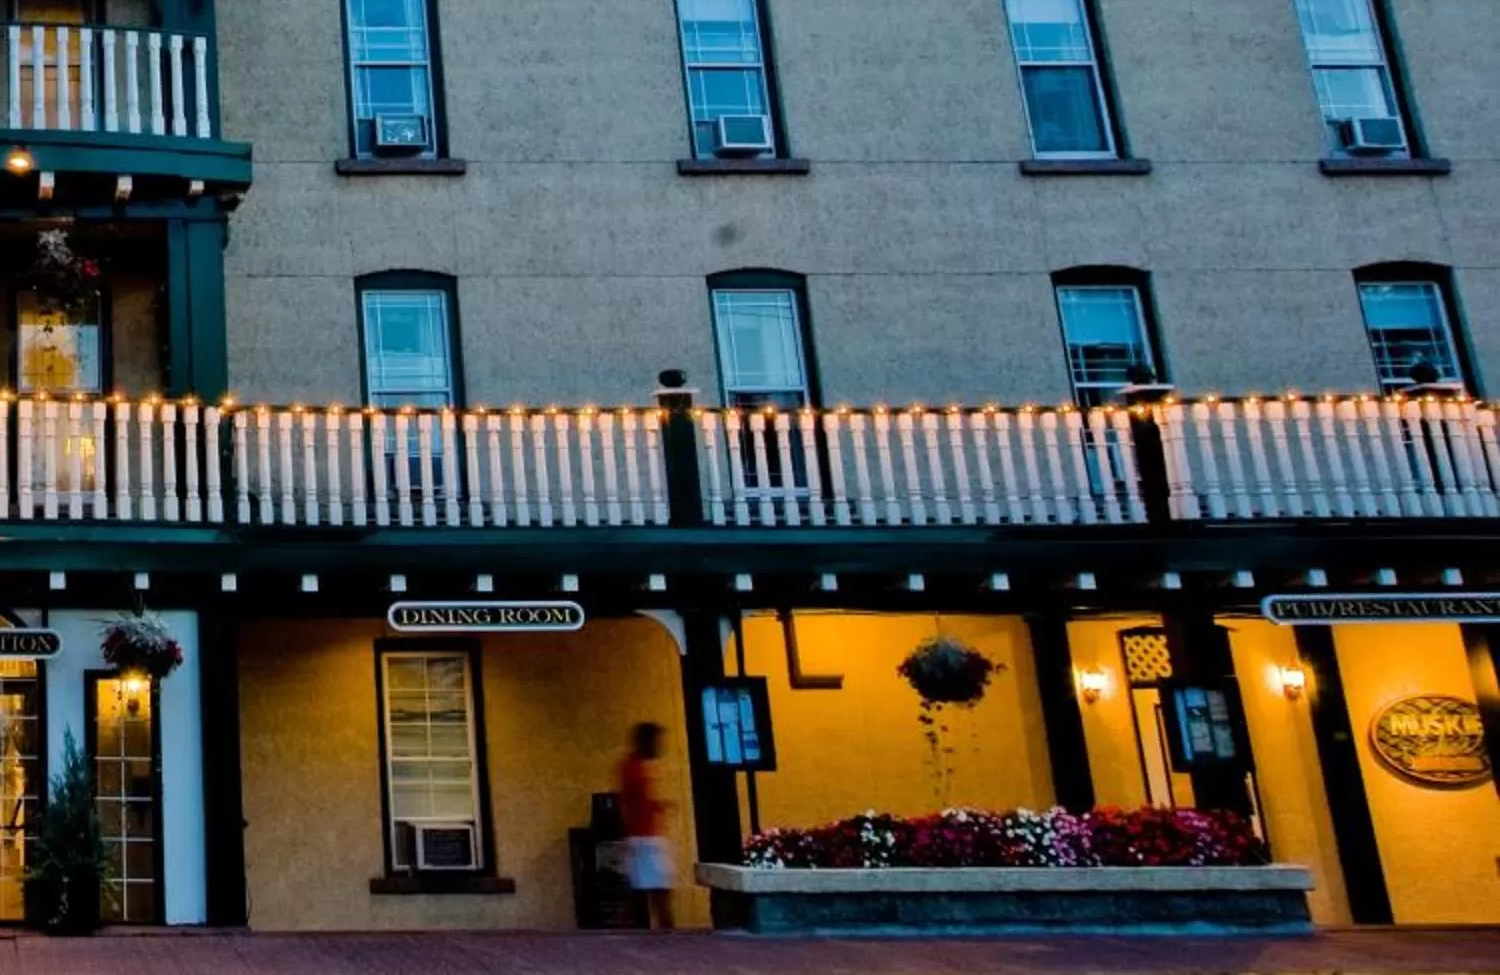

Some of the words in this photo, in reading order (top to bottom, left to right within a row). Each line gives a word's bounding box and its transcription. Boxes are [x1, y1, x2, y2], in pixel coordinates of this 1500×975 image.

[1274, 599, 1500, 616] PUB/RESTAURAN
[402, 608, 491, 624] DINING
[499, 608, 571, 623] ROOM
